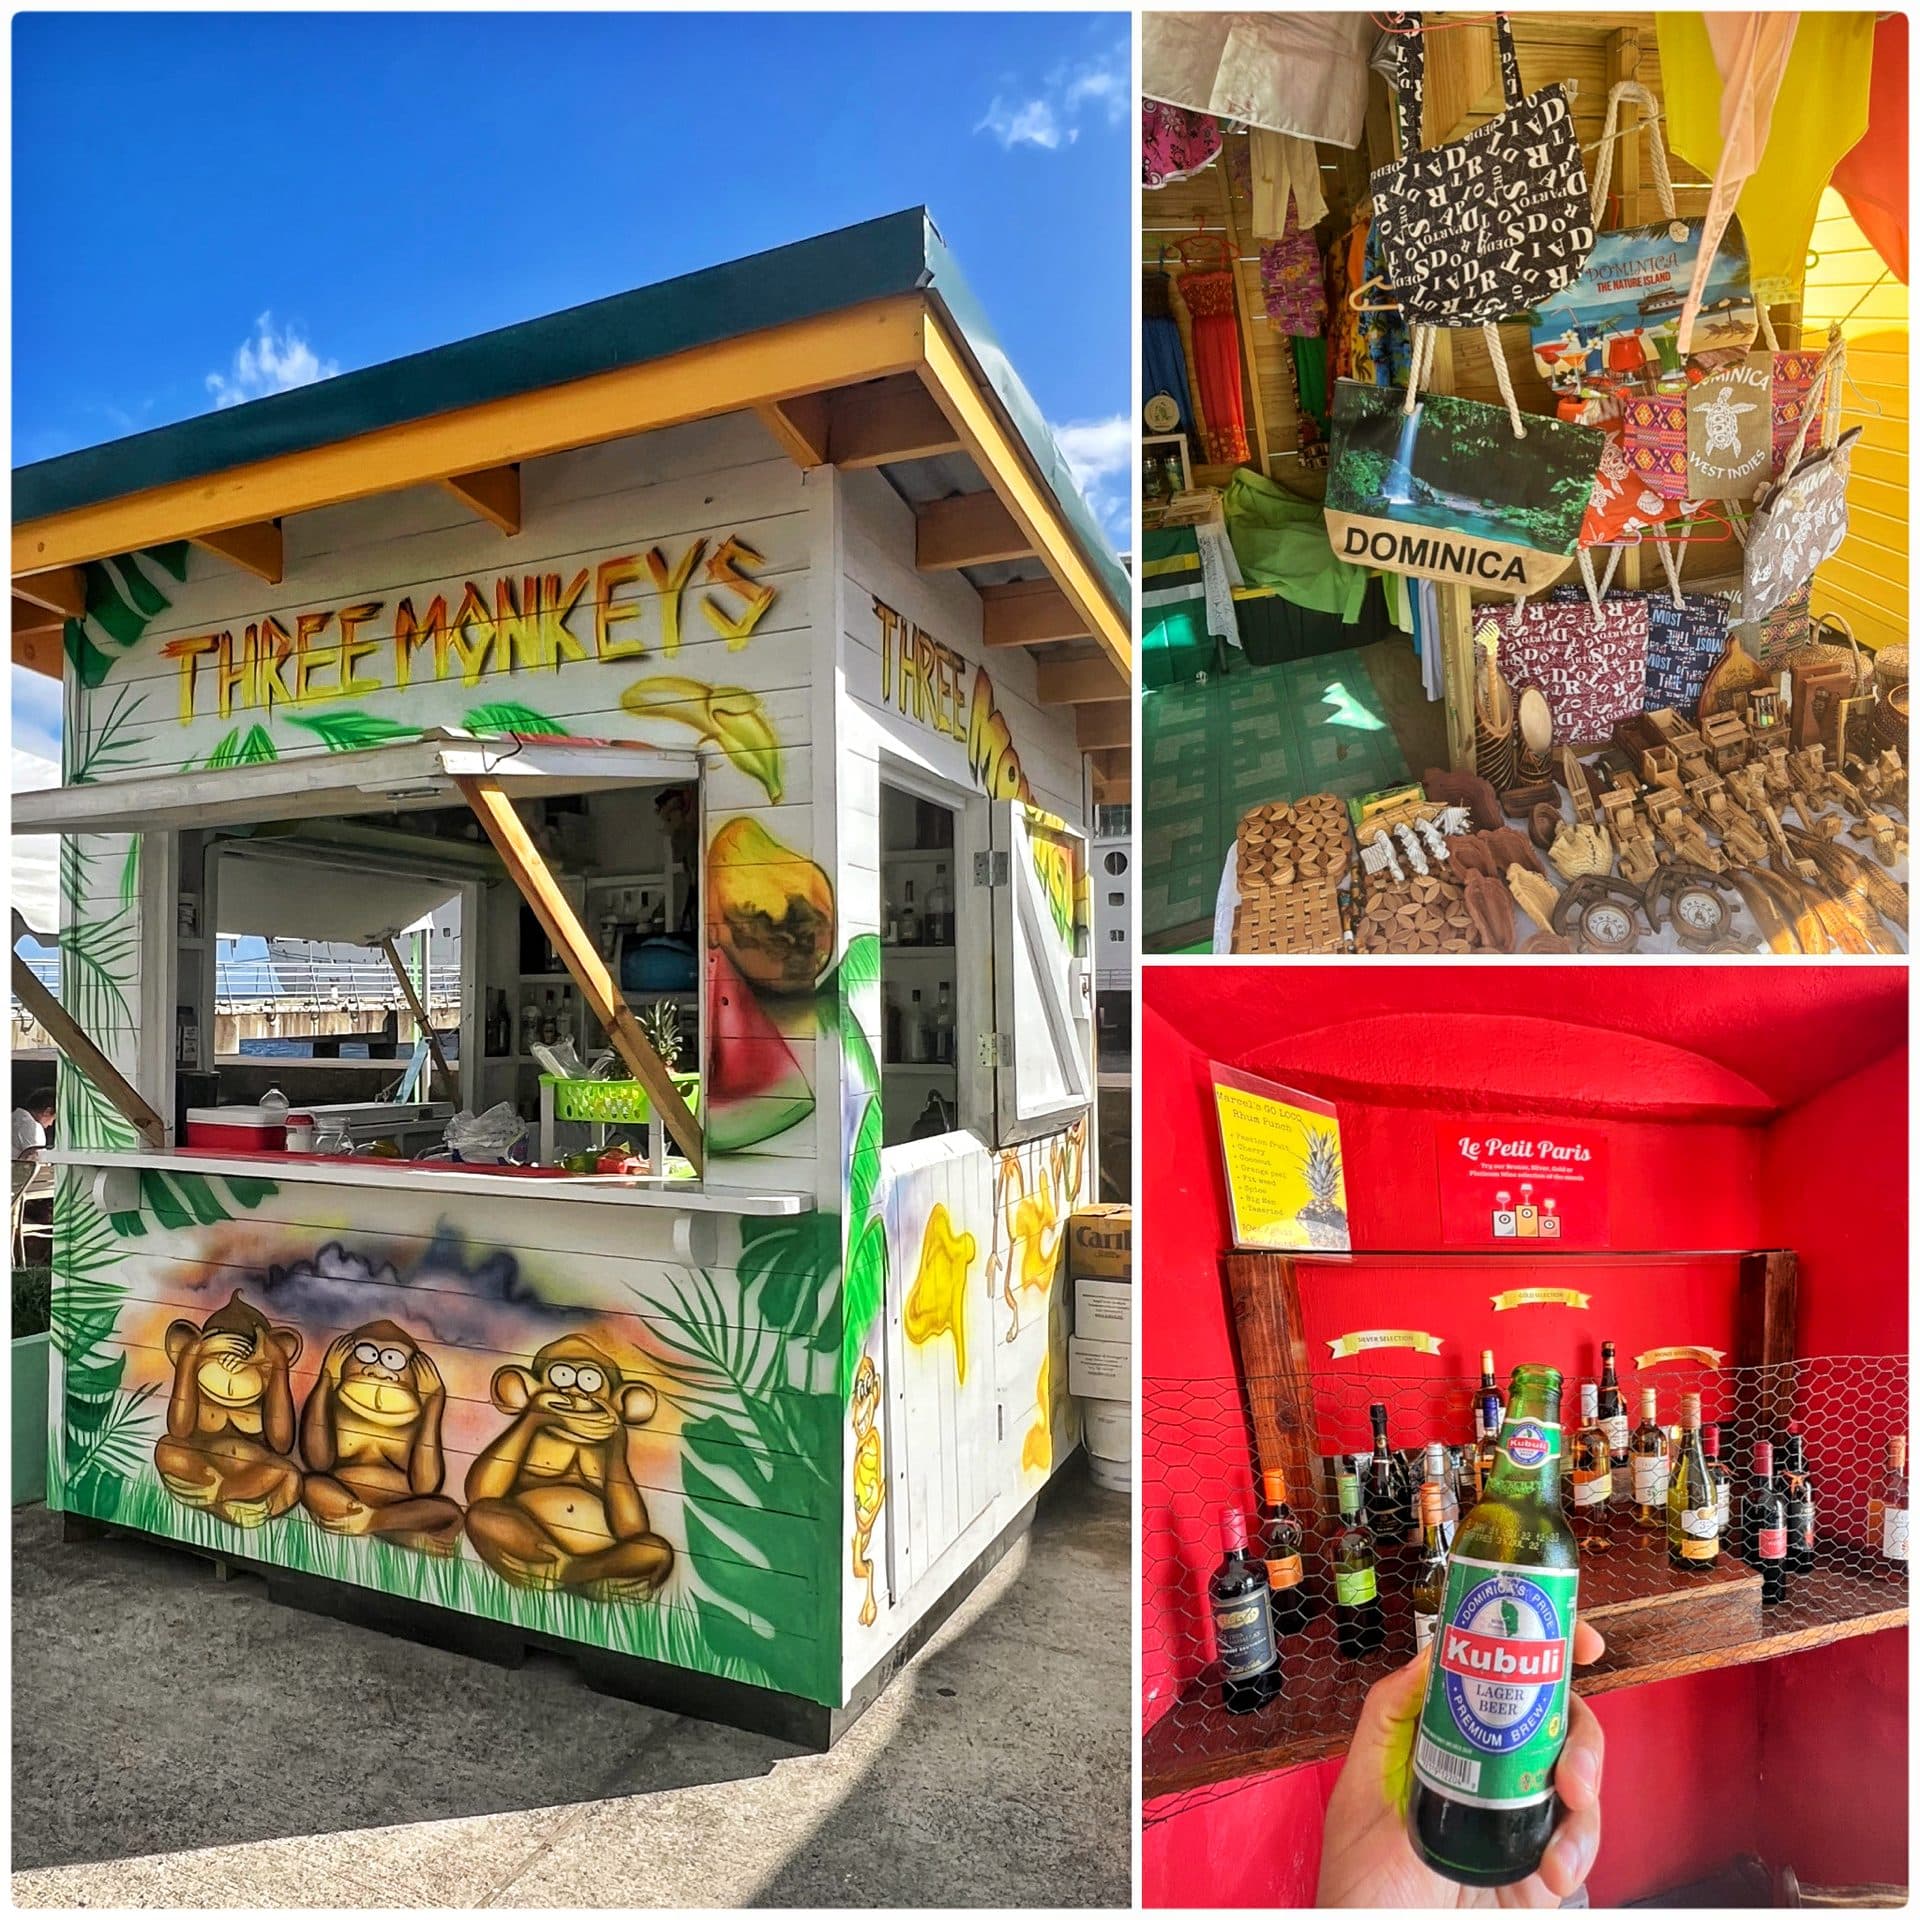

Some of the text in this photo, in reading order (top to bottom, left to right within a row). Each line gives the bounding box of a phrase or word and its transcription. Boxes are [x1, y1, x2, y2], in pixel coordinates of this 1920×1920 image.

[1585, 252, 1678, 282] DOMINICA
[1597, 272, 1671, 293] THE NATURE ISLAND
[1689, 450, 1725, 479] WEST
[1728, 449, 1766, 479] INDIES
[1344, 527, 1527, 584] DOMINICA
[159, 533, 777, 725] THREE MONKEYS
[1652, 609, 1682, 627] MOST
[872, 594, 967, 744] THREE
[1233, 1108, 1292, 1132] Rhum Punch
[1458, 1137, 1592, 1161] Le Petit Paris
[1510, 1439, 1547, 1450] Kubuli
[1532, 1594, 1555, 1629] PRIDE
[1447, 1635, 1561, 1675] Kubuli
[1476, 1684, 1524, 1701] LAGER
[1453, 1695, 1503, 1746] PREMIUM
[1511, 1705, 1544, 1742] BREW
[1479, 1701, 1518, 1715] BEER
